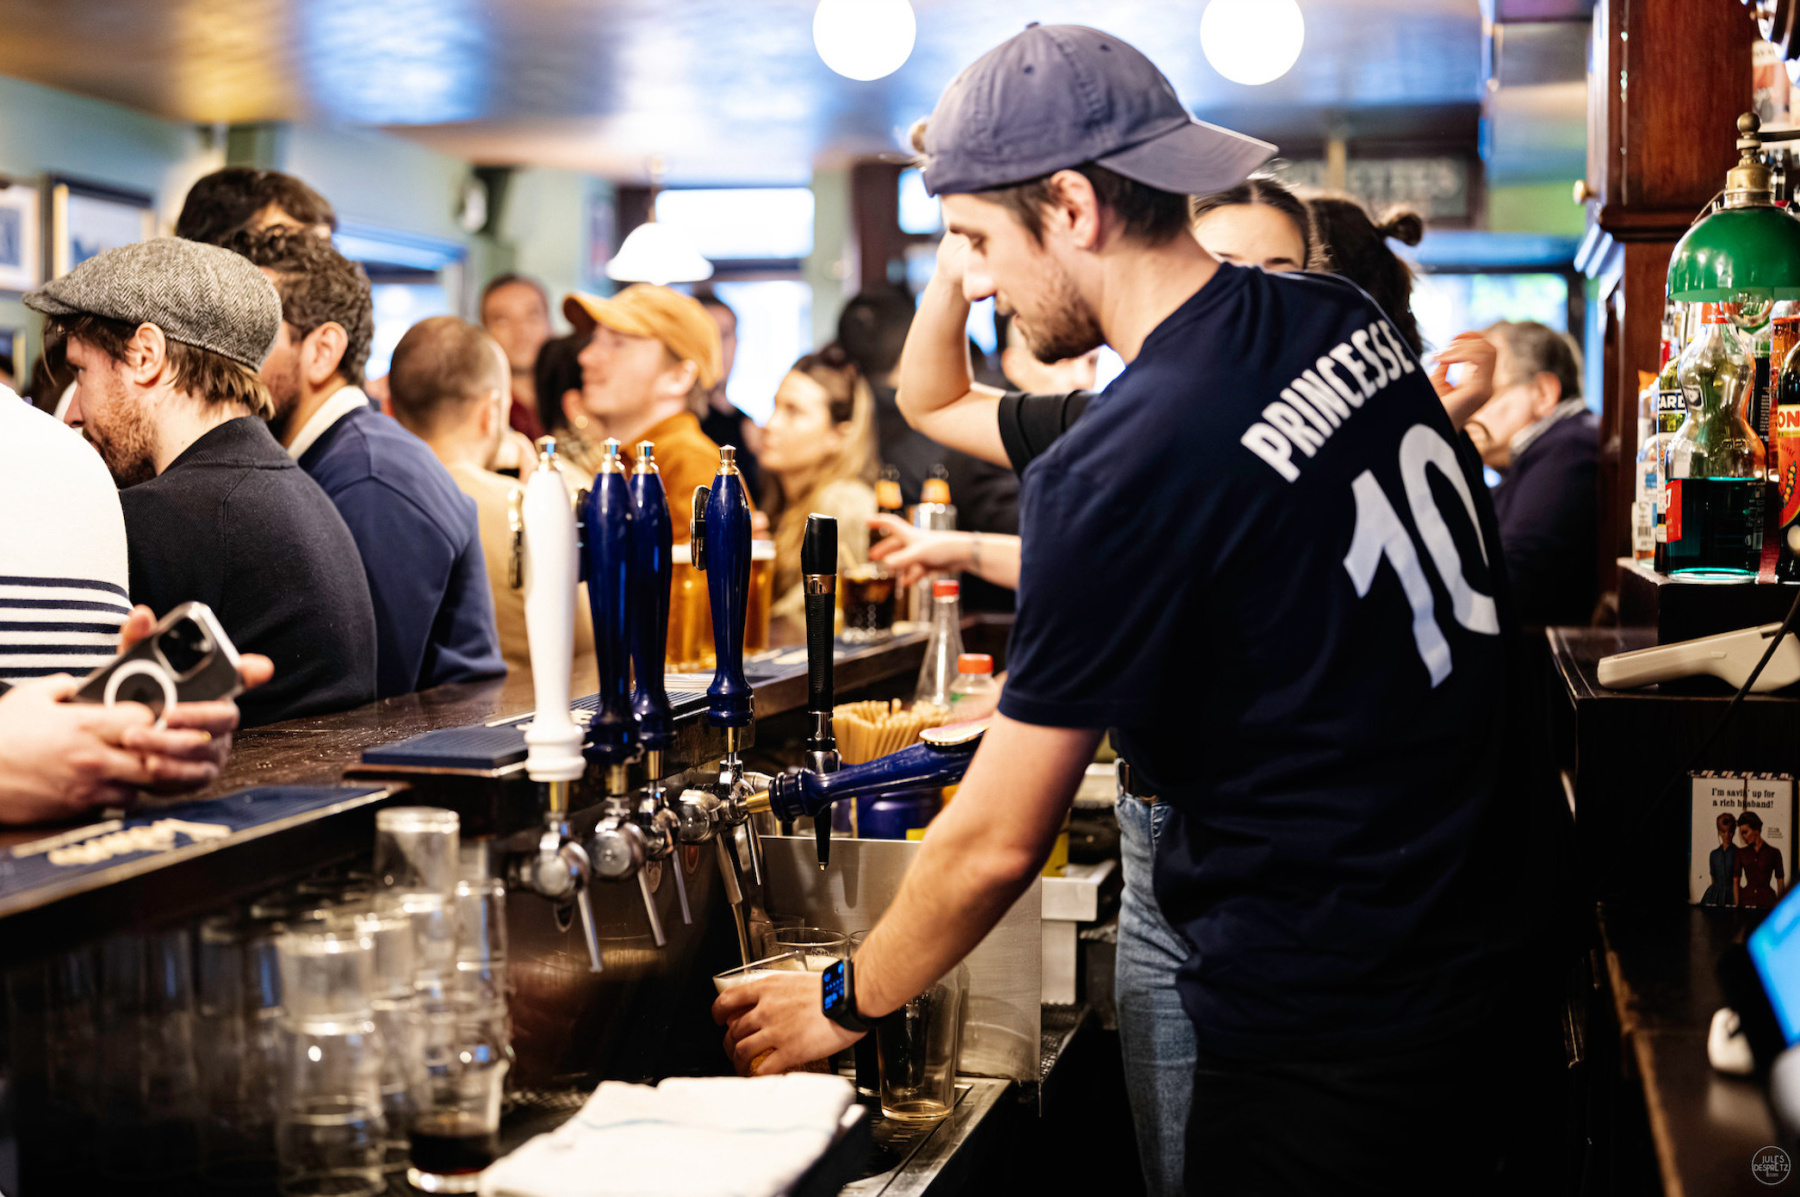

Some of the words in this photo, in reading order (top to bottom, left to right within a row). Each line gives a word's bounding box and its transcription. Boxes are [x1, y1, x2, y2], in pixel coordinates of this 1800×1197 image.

[1343, 423, 1500, 689] 10
[1712, 788, 1725, 796] I'm
[1727, 788, 1750, 797] savi'
[1764, 789, 1775, 798] for
[1720, 798, 1735, 807] rich
[1737, 799, 1774, 808] hsband!
